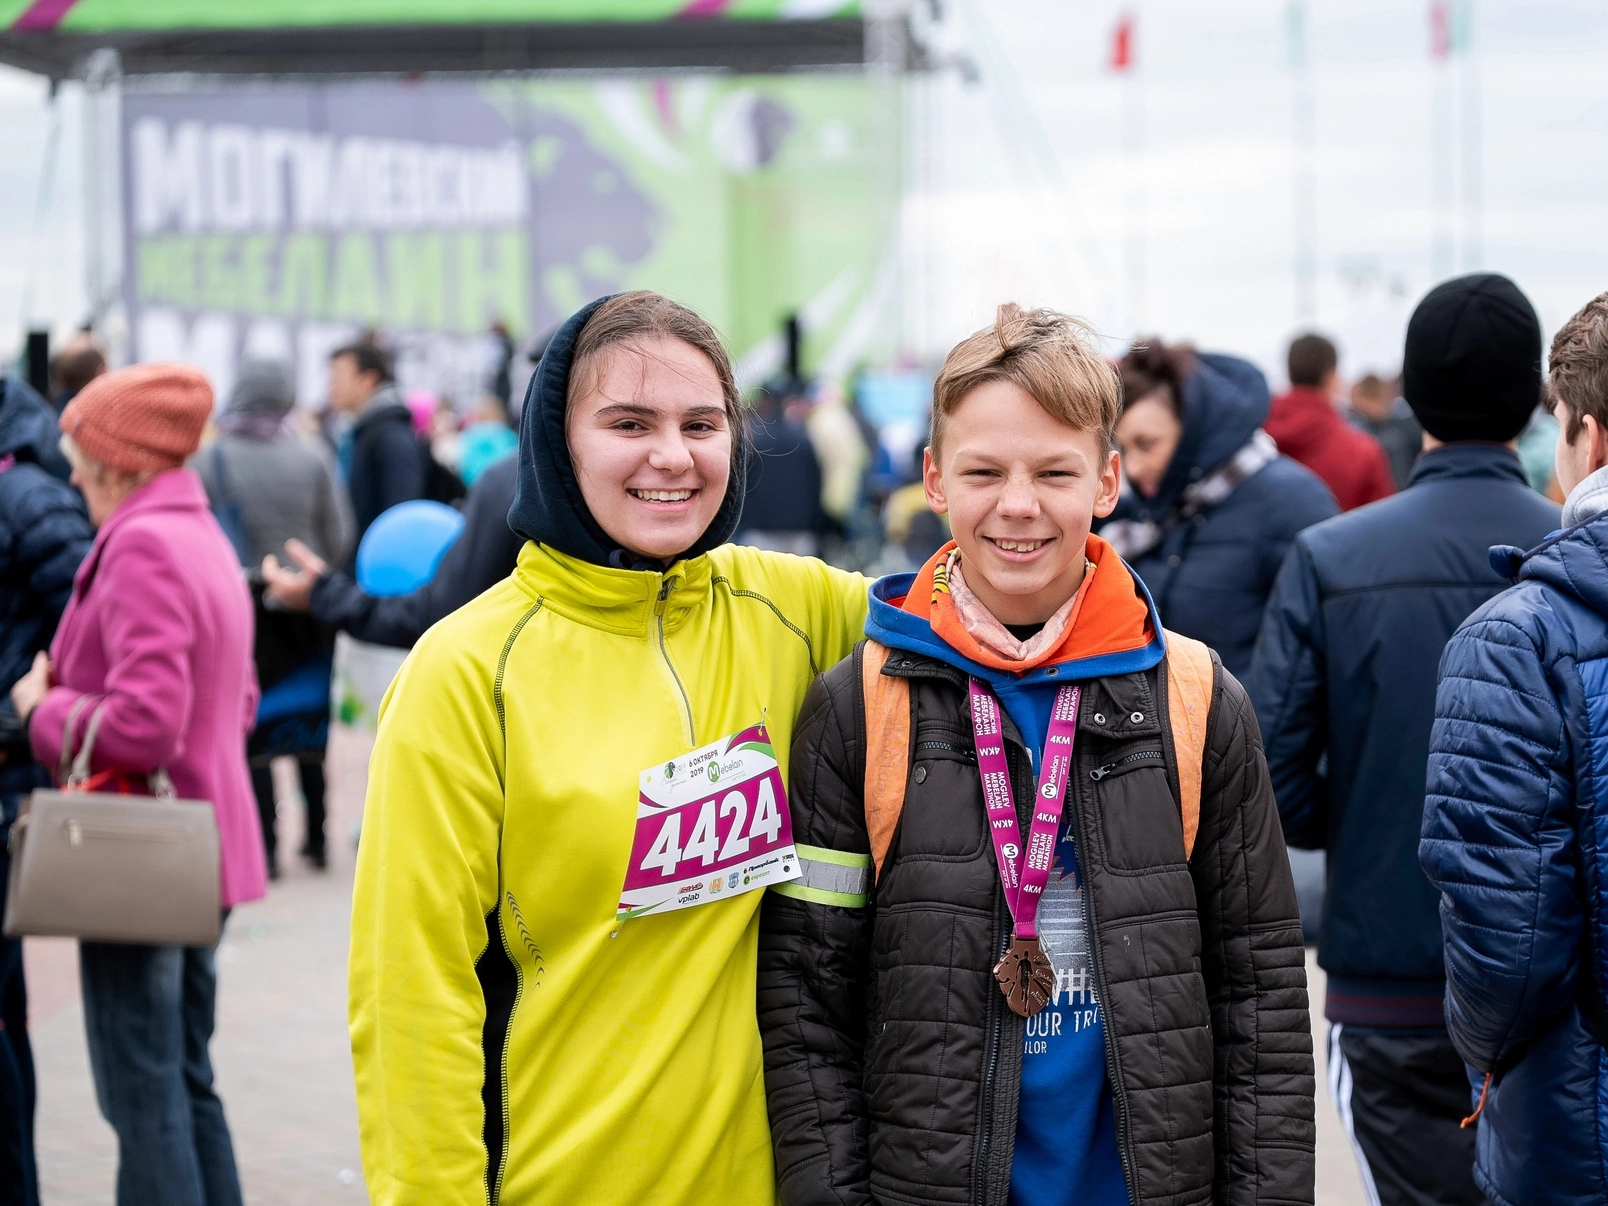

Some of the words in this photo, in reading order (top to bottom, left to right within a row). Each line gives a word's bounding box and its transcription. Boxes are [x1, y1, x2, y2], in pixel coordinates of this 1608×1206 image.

[973, 694, 984, 736] МАРАФОН
[980, 694, 991, 735] МЕБЕЛАИН
[1067, 685, 1080, 722] МАРАФОН
[693, 750, 718, 765] ОКТЯБРЯ
[979, 746, 1000, 757] 4KM
[1050, 735, 1070, 745] 4KM
[690, 767, 704, 778] 2019
[990, 772, 1003, 809] MEBELAIN
[997, 771, 1011, 808] MOGILEV
[984, 773, 996, 810] MARATHON
[640, 776, 782, 877] 4424
[992, 819, 1014, 829] 4KM
[1036, 812, 1057, 824] 4KM
[1028, 832, 1041, 869] MOGILEV
[1035, 833, 1048, 870] MEBELAIN
[1042, 834, 1054, 871] MARATHON
[678, 892, 700, 904] vplab
[1023, 884, 1042, 894] 4KM
[1026, 1012, 1062, 1037] OUR
